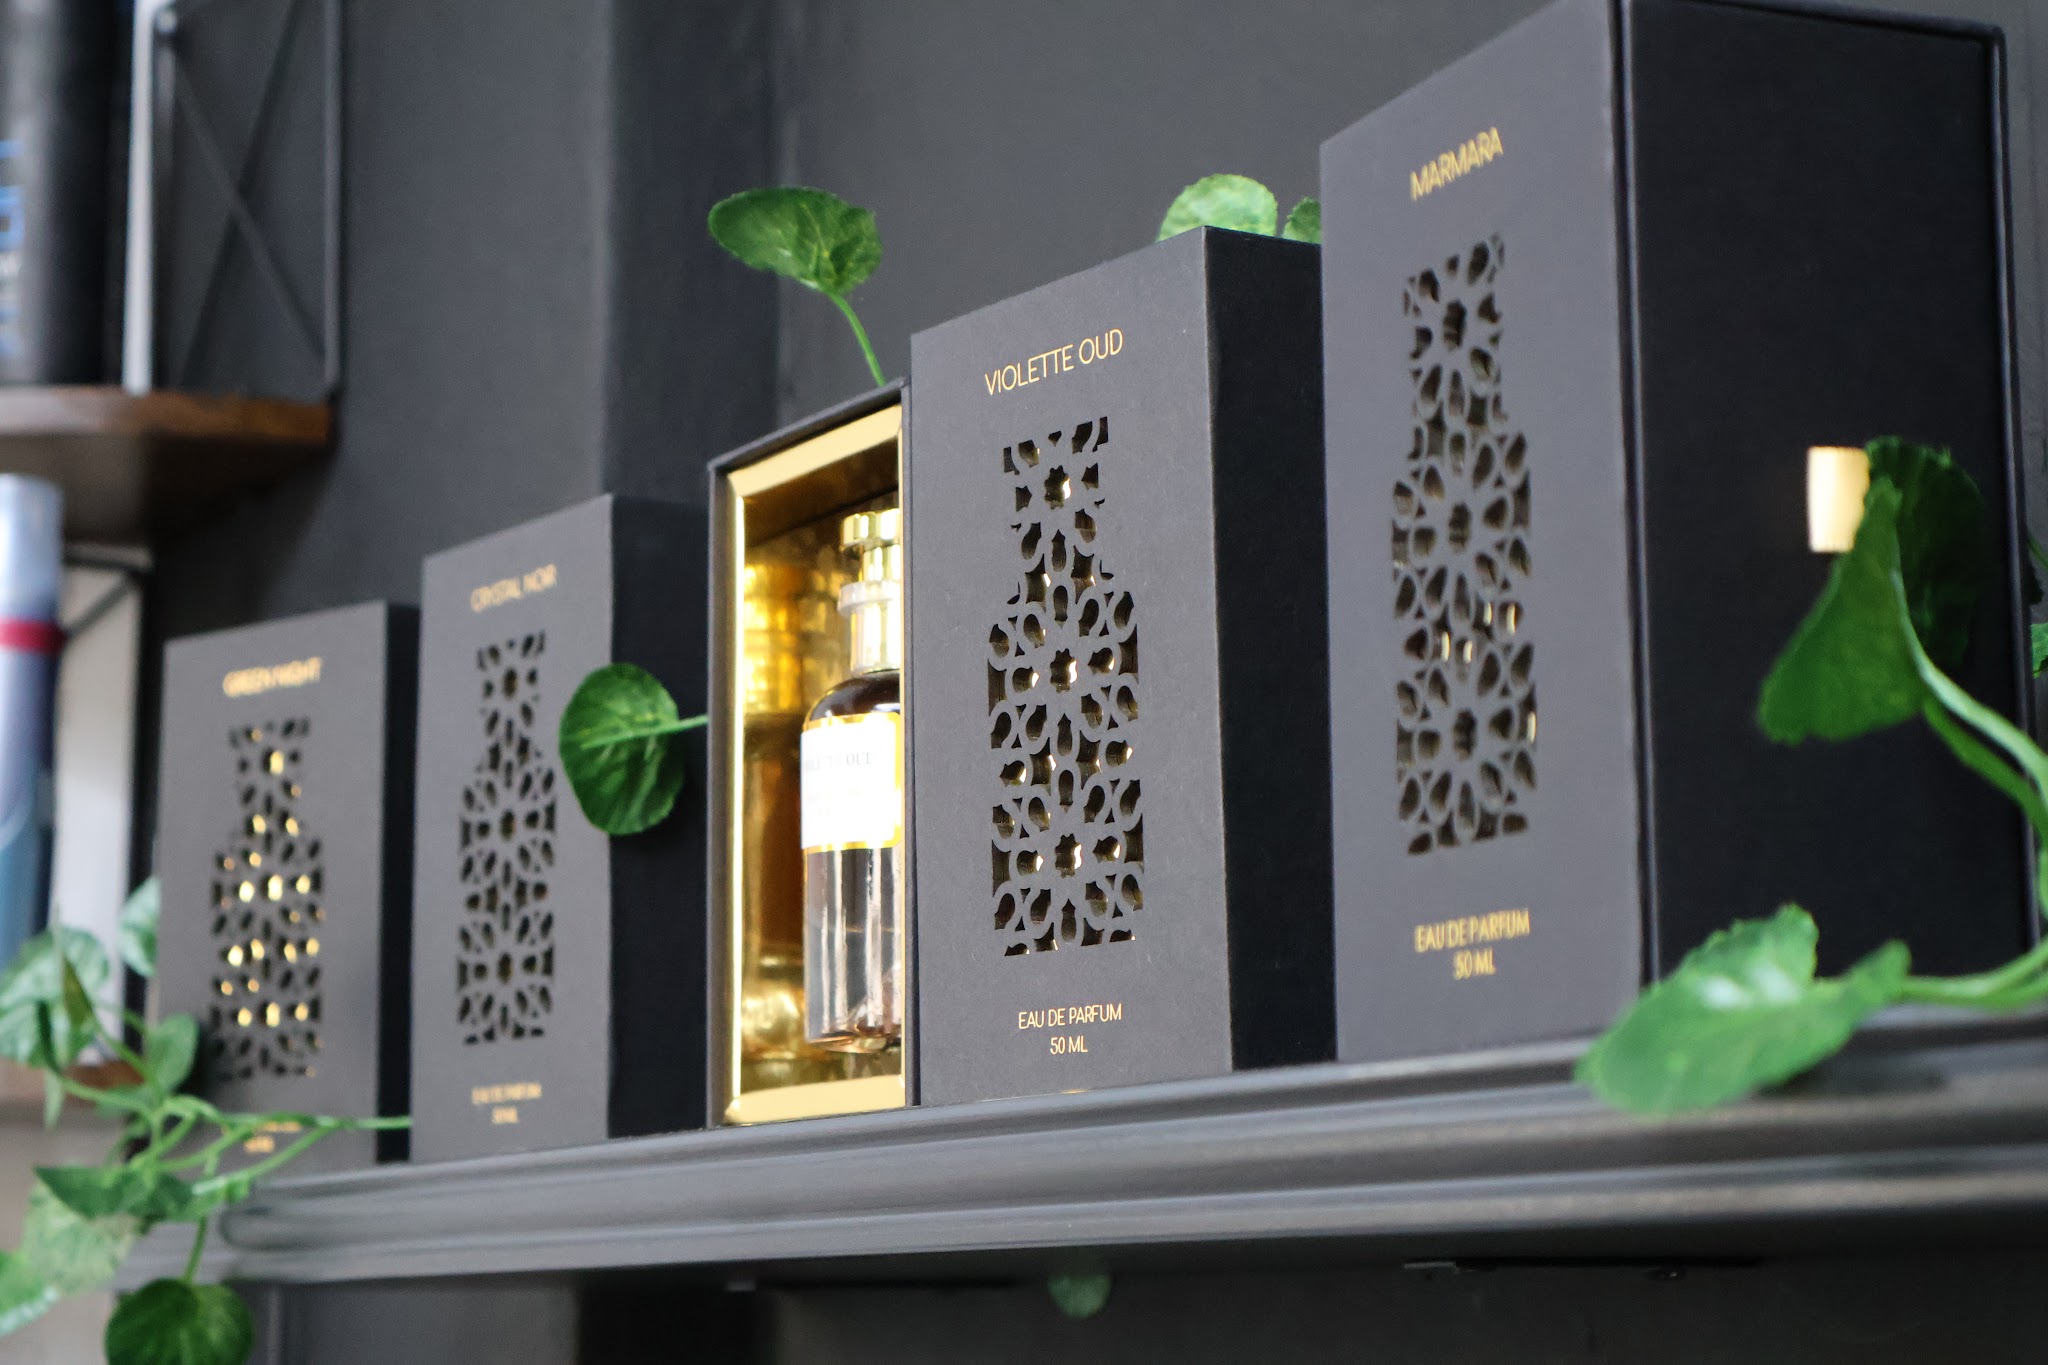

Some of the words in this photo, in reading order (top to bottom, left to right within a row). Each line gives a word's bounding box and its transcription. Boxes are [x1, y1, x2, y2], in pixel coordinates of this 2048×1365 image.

[1410, 126, 1504, 201] MARMARA
[984, 343, 1075, 396] VIOLETTE
[1078, 328, 1123, 365] OUD
[1414, 922, 1446, 953] EAU
[1446, 917, 1467, 949] DE
[1469, 907, 1531, 943] PARFUM
[1453, 949, 1473, 980] 50
[1475, 946, 1497, 976] ML
[1018, 1010, 1046, 1030] EAU
[1047, 1007, 1066, 1027] DE
[1068, 1002, 1122, 1024] PARFUM
[1049, 1036, 1066, 1055] 50
[1068, 1035, 1089, 1053] ML
